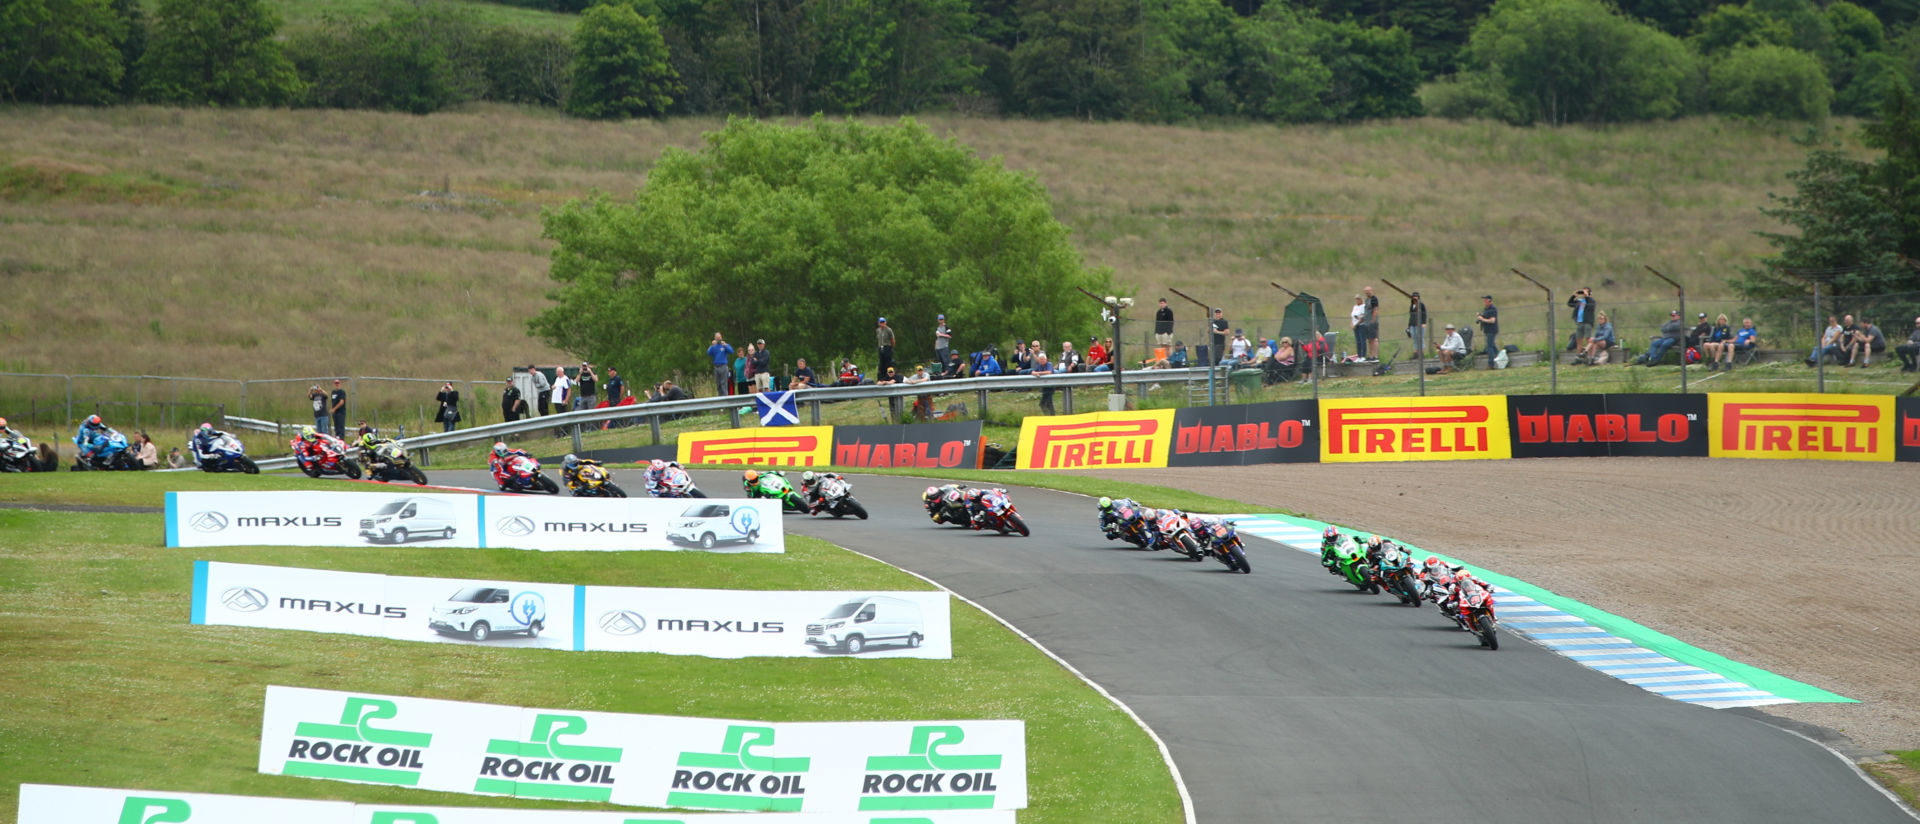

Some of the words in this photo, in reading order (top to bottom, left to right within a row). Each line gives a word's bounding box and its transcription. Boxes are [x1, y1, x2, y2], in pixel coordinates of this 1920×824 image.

[1176, 418, 1303, 454] DIABLO
[1327, 405, 1488, 454] PIRELLI
[1517, 408, 1689, 443] DIABLO
[1722, 403, 1881, 453] PIRELLI
[835, 436, 964, 468] DIABLO
[1030, 419, 1158, 468] PIRELLI
[237, 516, 342, 527] MAXUS
[544, 521, 647, 533] MAXUS
[279, 597, 407, 619] MAXUS
[657, 618, 784, 633] MAXUS
[288, 739, 373, 764] ROCK
[376, 747, 424, 769] OIL
[480, 756, 564, 781] ROCK
[567, 763, 616, 785] OIL
[671, 770, 756, 793] ROCK
[759, 775, 806, 795] OIL
[862, 773, 945, 794] ROCK
[950, 772, 998, 792] OIL
